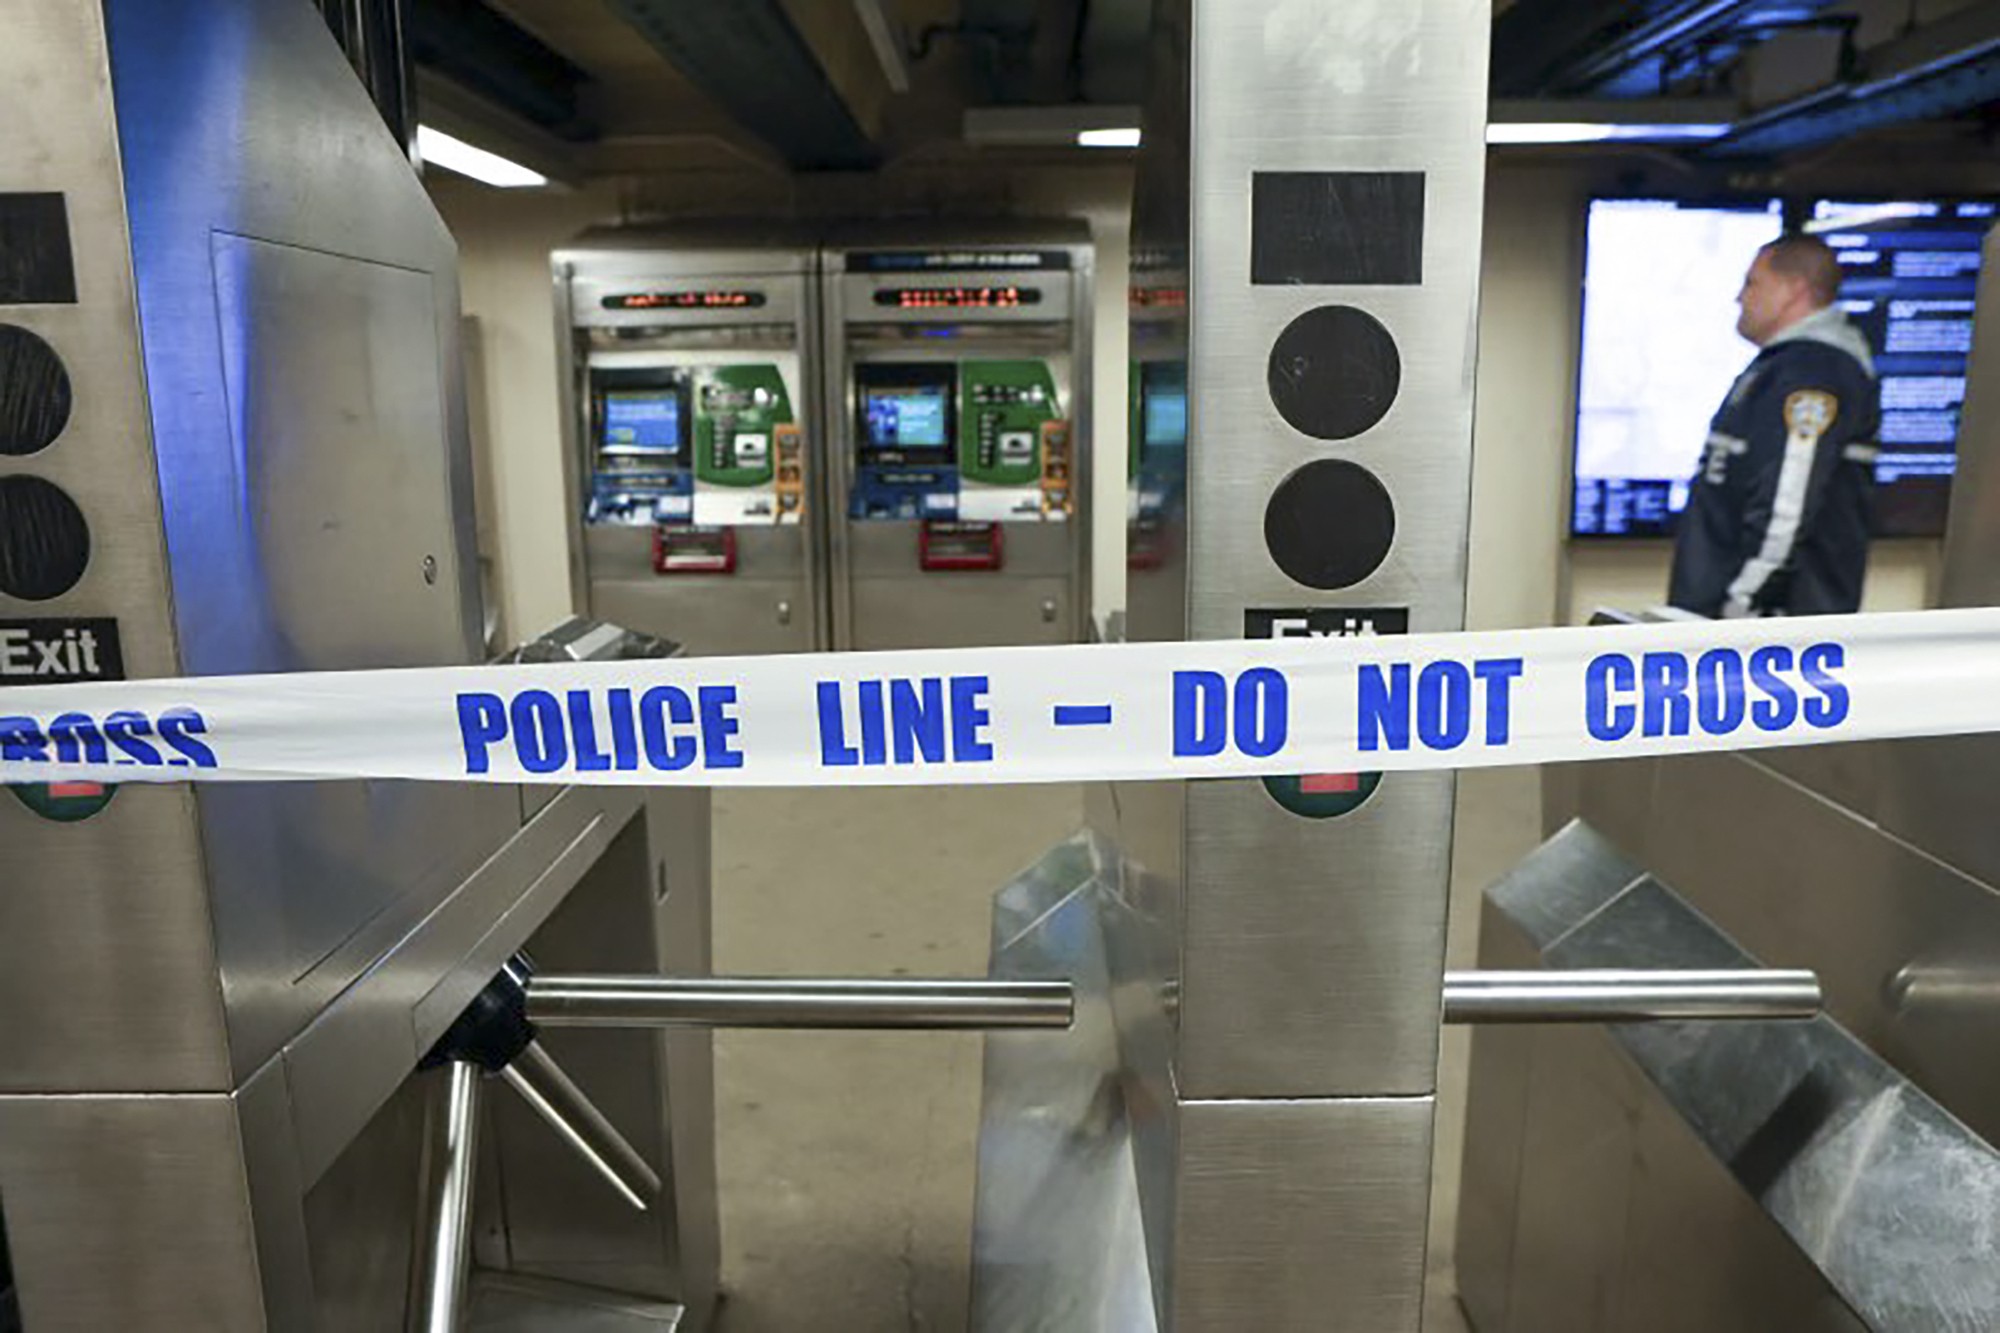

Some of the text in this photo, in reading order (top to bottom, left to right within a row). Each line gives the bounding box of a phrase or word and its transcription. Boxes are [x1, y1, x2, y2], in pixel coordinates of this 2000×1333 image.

[0, 628, 100, 675] Exit
[457, 685, 744, 774] POLICE
[817, 676, 993, 767] LINE
[1173, 666, 1289, 757] DO
[1357, 657, 1523, 751] NOT
[1585, 642, 1850, 742] CROSS
